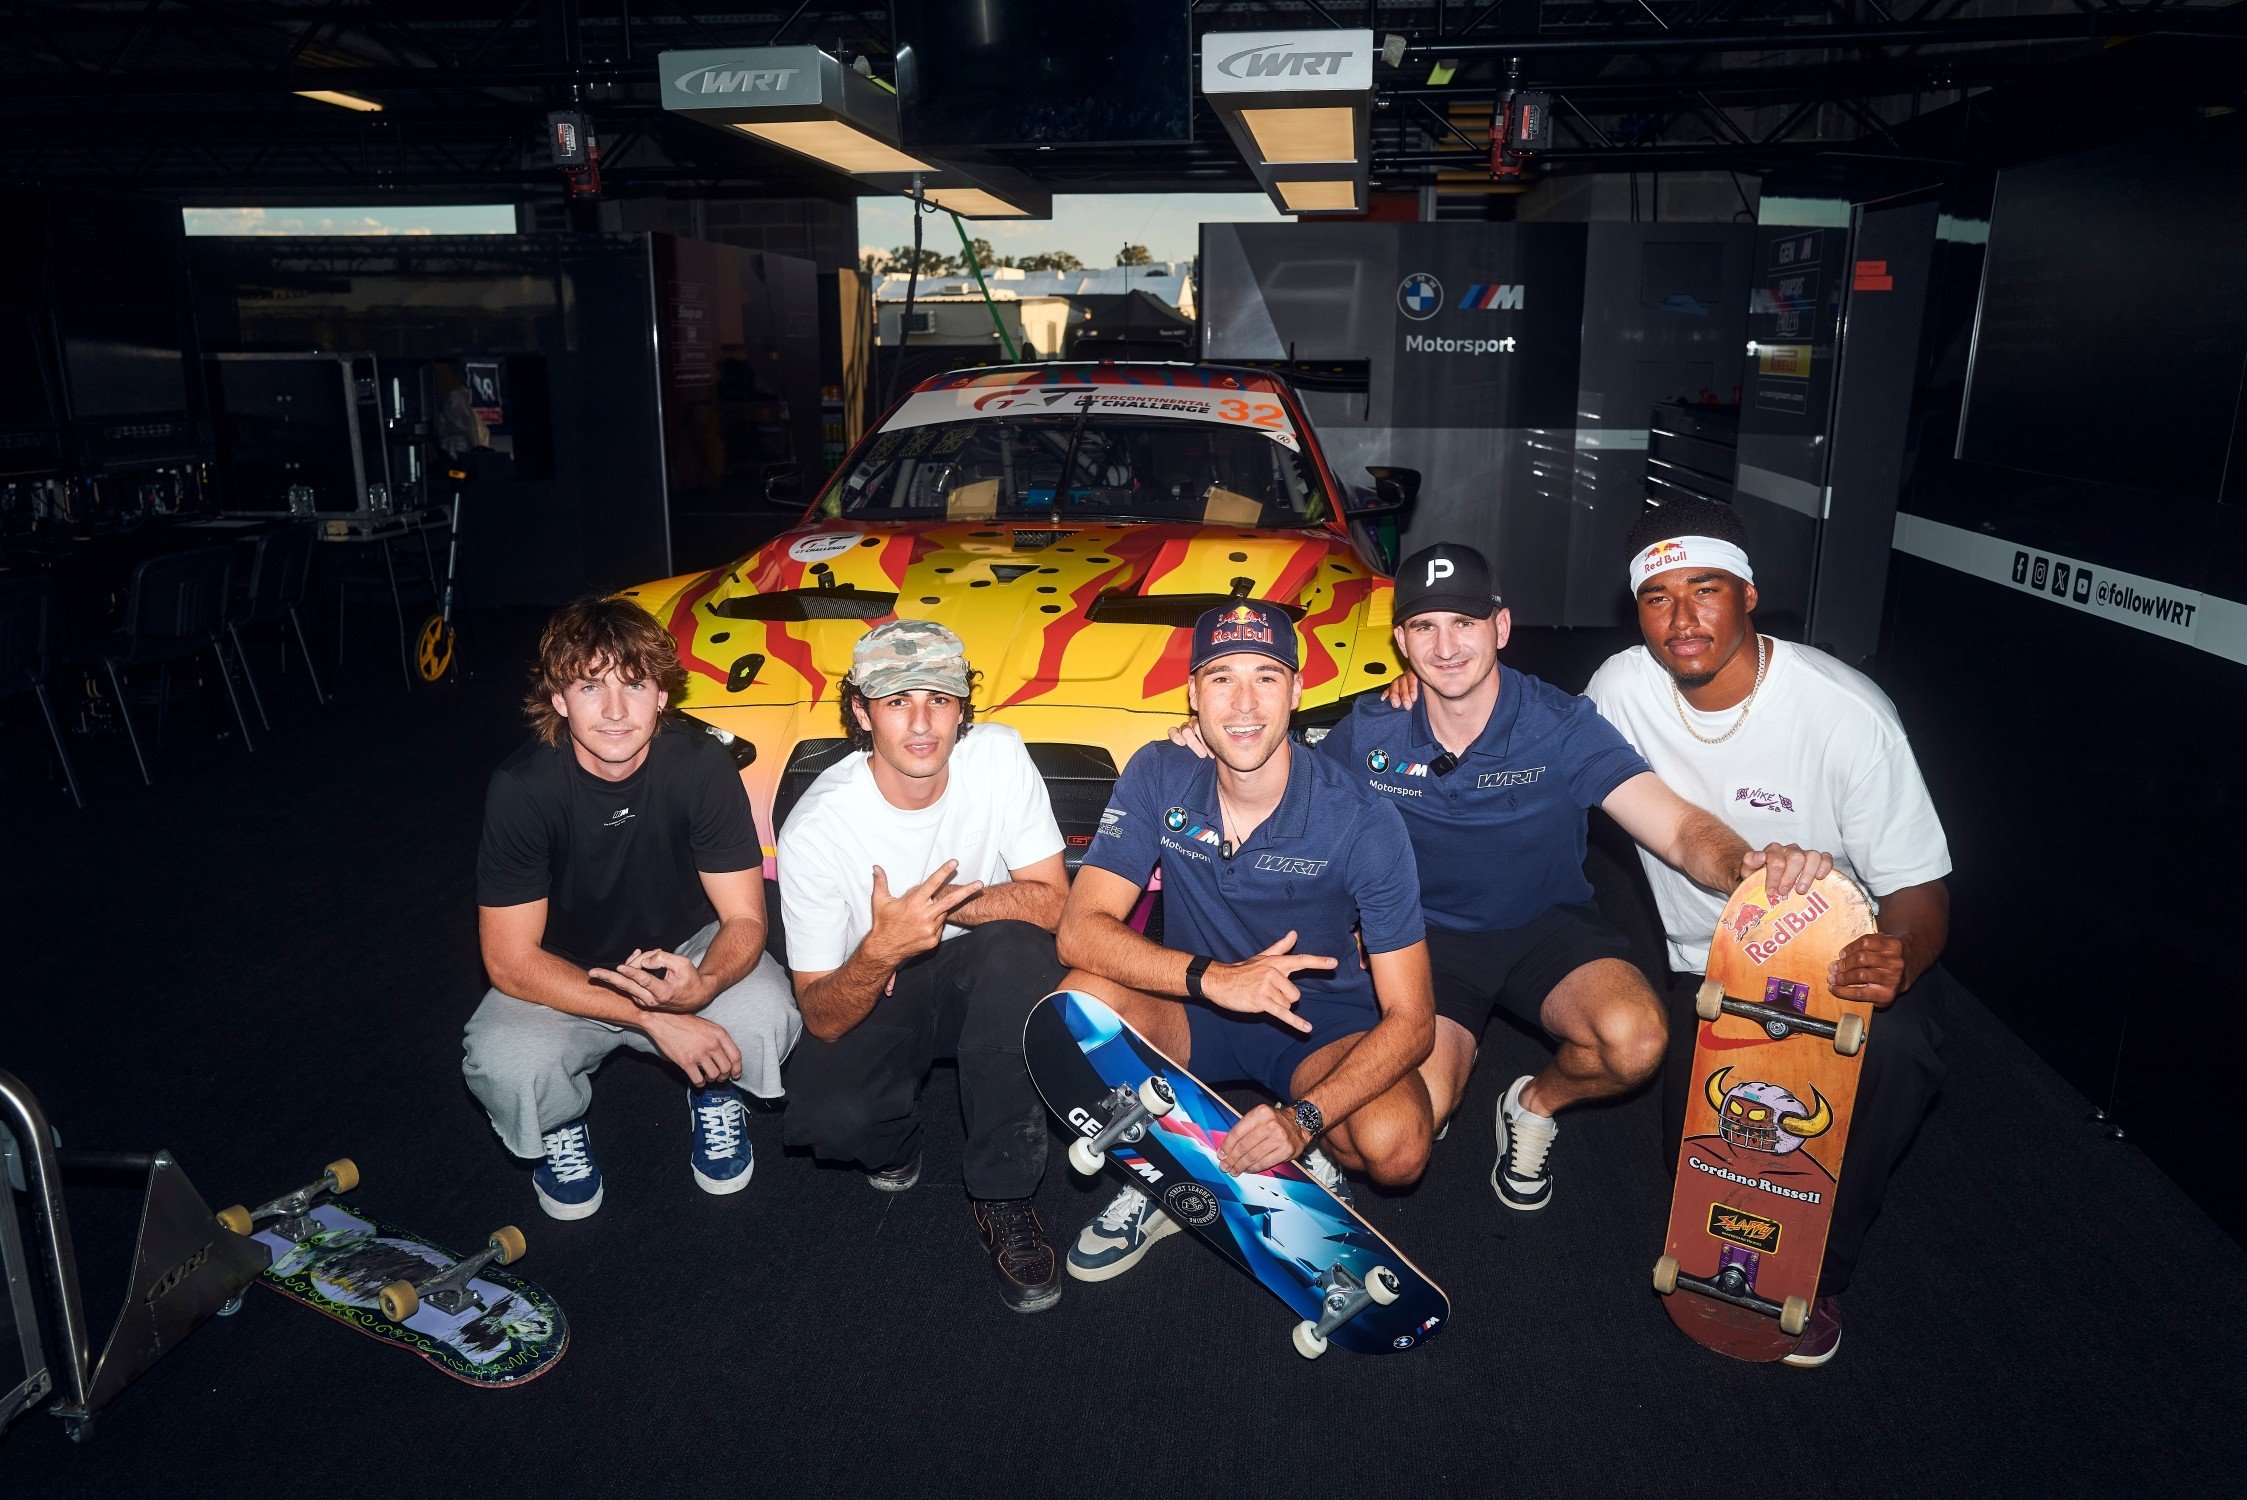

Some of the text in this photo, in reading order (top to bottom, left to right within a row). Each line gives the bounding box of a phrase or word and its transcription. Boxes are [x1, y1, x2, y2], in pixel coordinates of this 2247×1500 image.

[1246, 51, 1354, 77] WRT
[701, 68, 800, 94] WRT
[1405, 335, 1517, 356] Motorsport
[1101, 400, 1211, 414] CHALLENGE
[1218, 398, 1284, 429] 32
[1644, 551, 1687, 573] Red Bull
[2096, 580, 2196, 627] @followWRT
[1212, 624, 1274, 645] Red Bull
[1369, 779, 1423, 798] Motorsport
[1477, 766, 1546, 789] WRT
[1747, 788, 1775, 801] NIKE
[1255, 854, 1329, 876] WRT
[1745, 890, 1830, 965] Red Bull
[1068, 1107, 1105, 1140] GE
[1688, 1156, 1821, 1204] Cordano Russell
